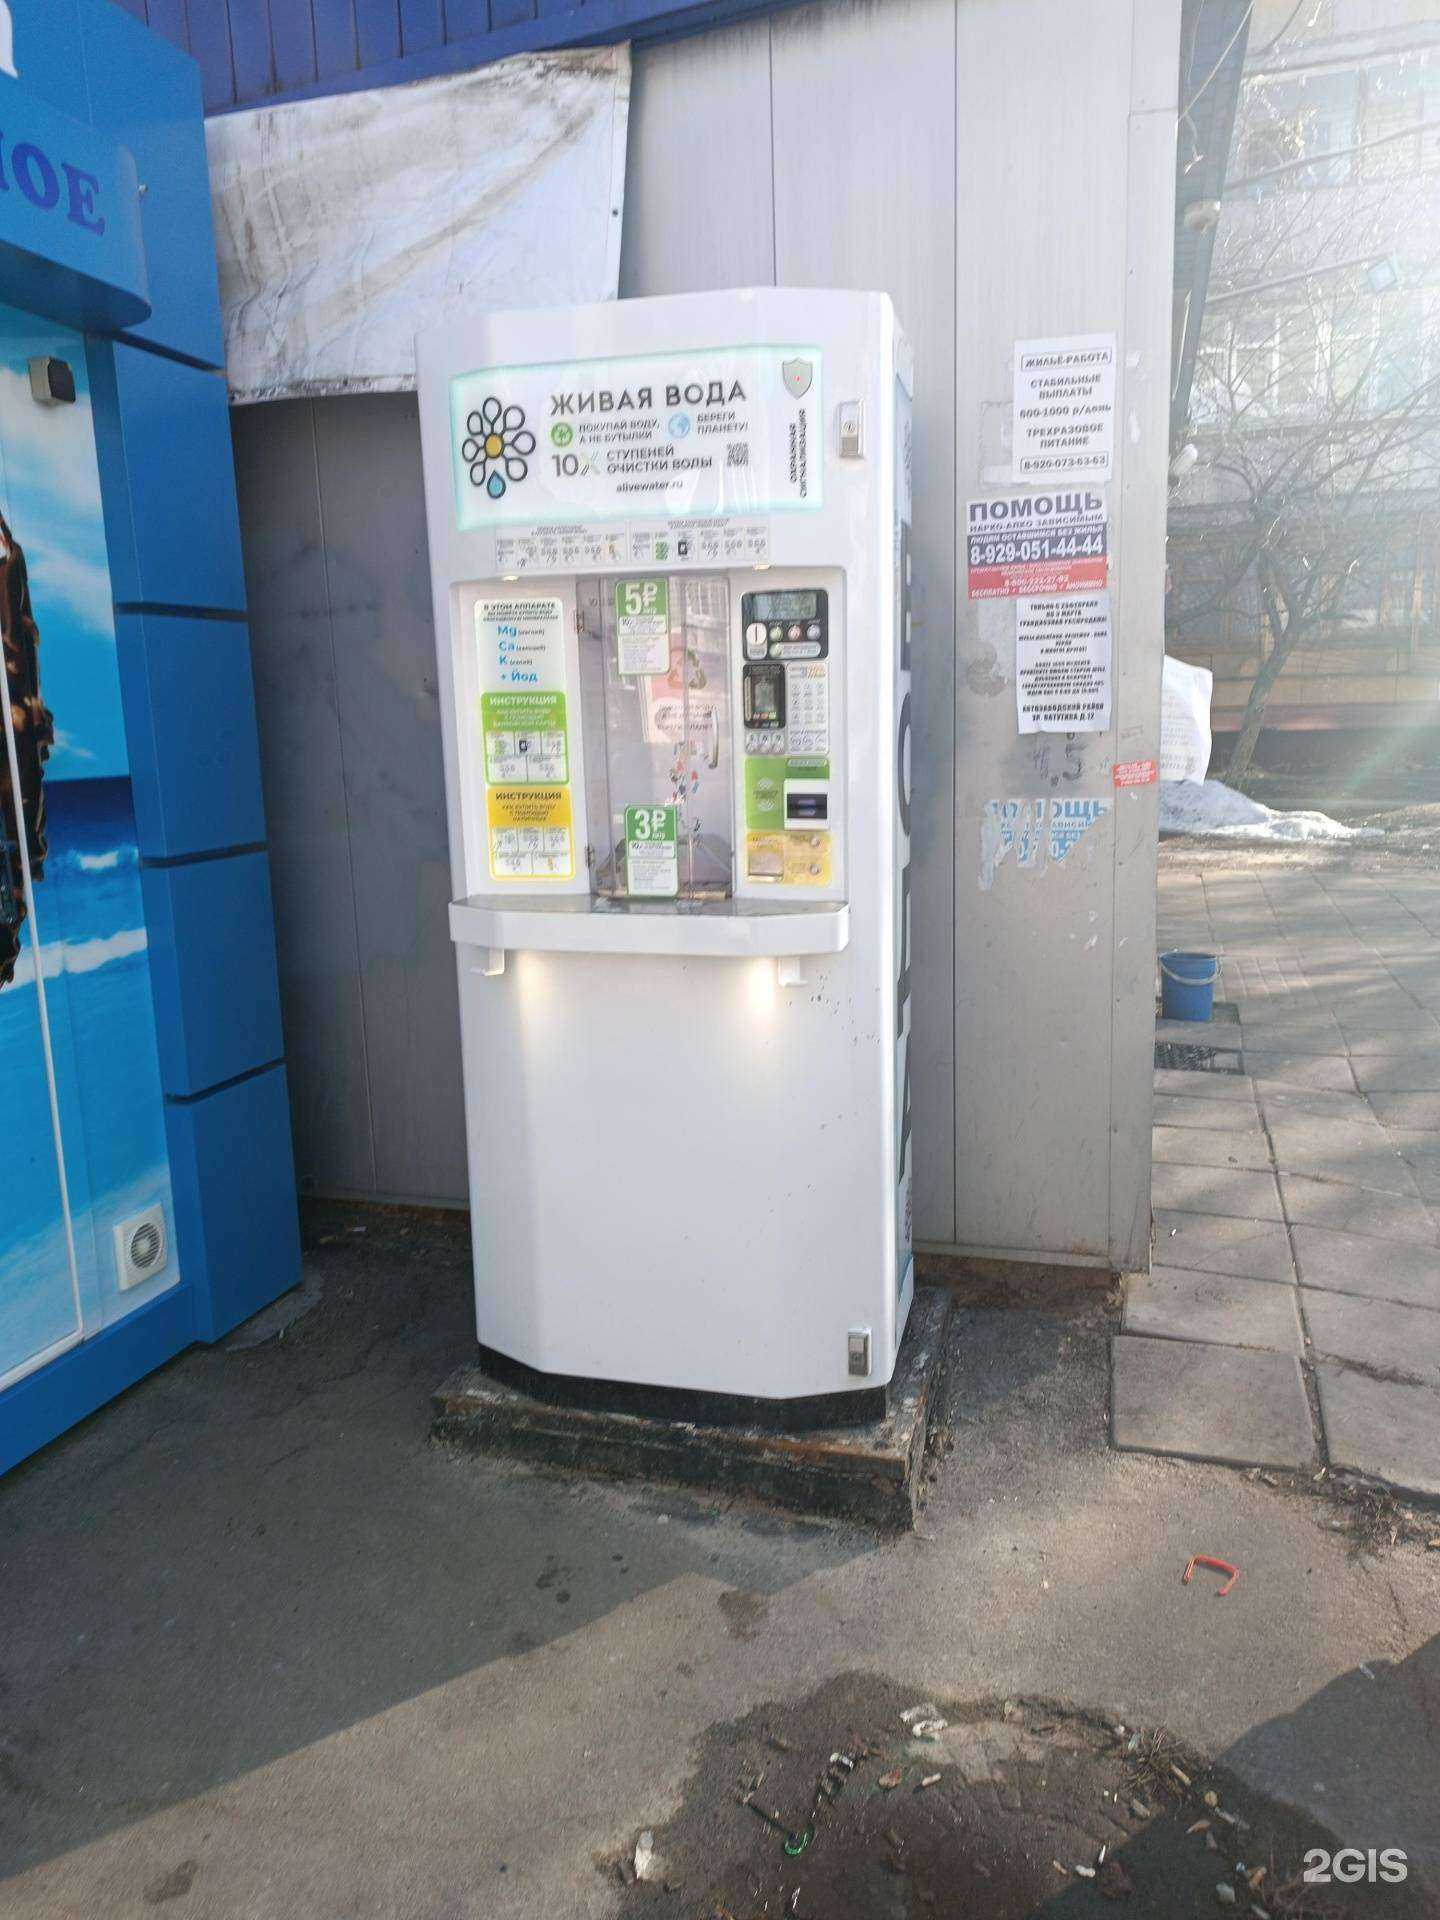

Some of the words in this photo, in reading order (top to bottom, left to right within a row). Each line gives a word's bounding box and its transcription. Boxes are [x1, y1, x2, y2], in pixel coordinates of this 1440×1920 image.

[1031, 374, 1101, 389] СТАБИЛЬНЫЕ
[551, 386, 653, 416] ЖИВАЯ
[665, 380, 747, 407] ВОДА
[1039, 387, 1092, 400] ВЫПЛАТЫ
[697, 411, 736, 423] БЕРЕГИ
[579, 420, 627, 433] ПОКУПАЙ
[697, 422, 749, 435] ПЛАНЕТУ!
[1027, 423, 1104, 438] ТРЕХРАЗОВОЕ
[579, 436, 587, 444] А
[589, 435, 601, 443] НЕ
[604, 431, 653, 443] БУТЫЛКИ
[1040, 436, 1090, 449] ПИТАНИЕ
[606, 444, 675, 461] СТУПЕНЕЙ
[607, 459, 668, 474] ОЧИСТКИ
[672, 456, 713, 470] ВОДЫ
[616, 481, 684, 492] alivewater.ru
[970, 492, 1103, 522] ПОМОЩЬ
[970, 534, 1103, 565] 8-929-051-44-44
[498, 625, 517, 637] Mg
[498, 641, 516, 652] Ca
[511, 669, 538, 682] Йод
[490, 695, 557, 706] ИНСТРУКЦИЯ
[496, 791, 562, 800] ИНСТРУКЦИЯ
